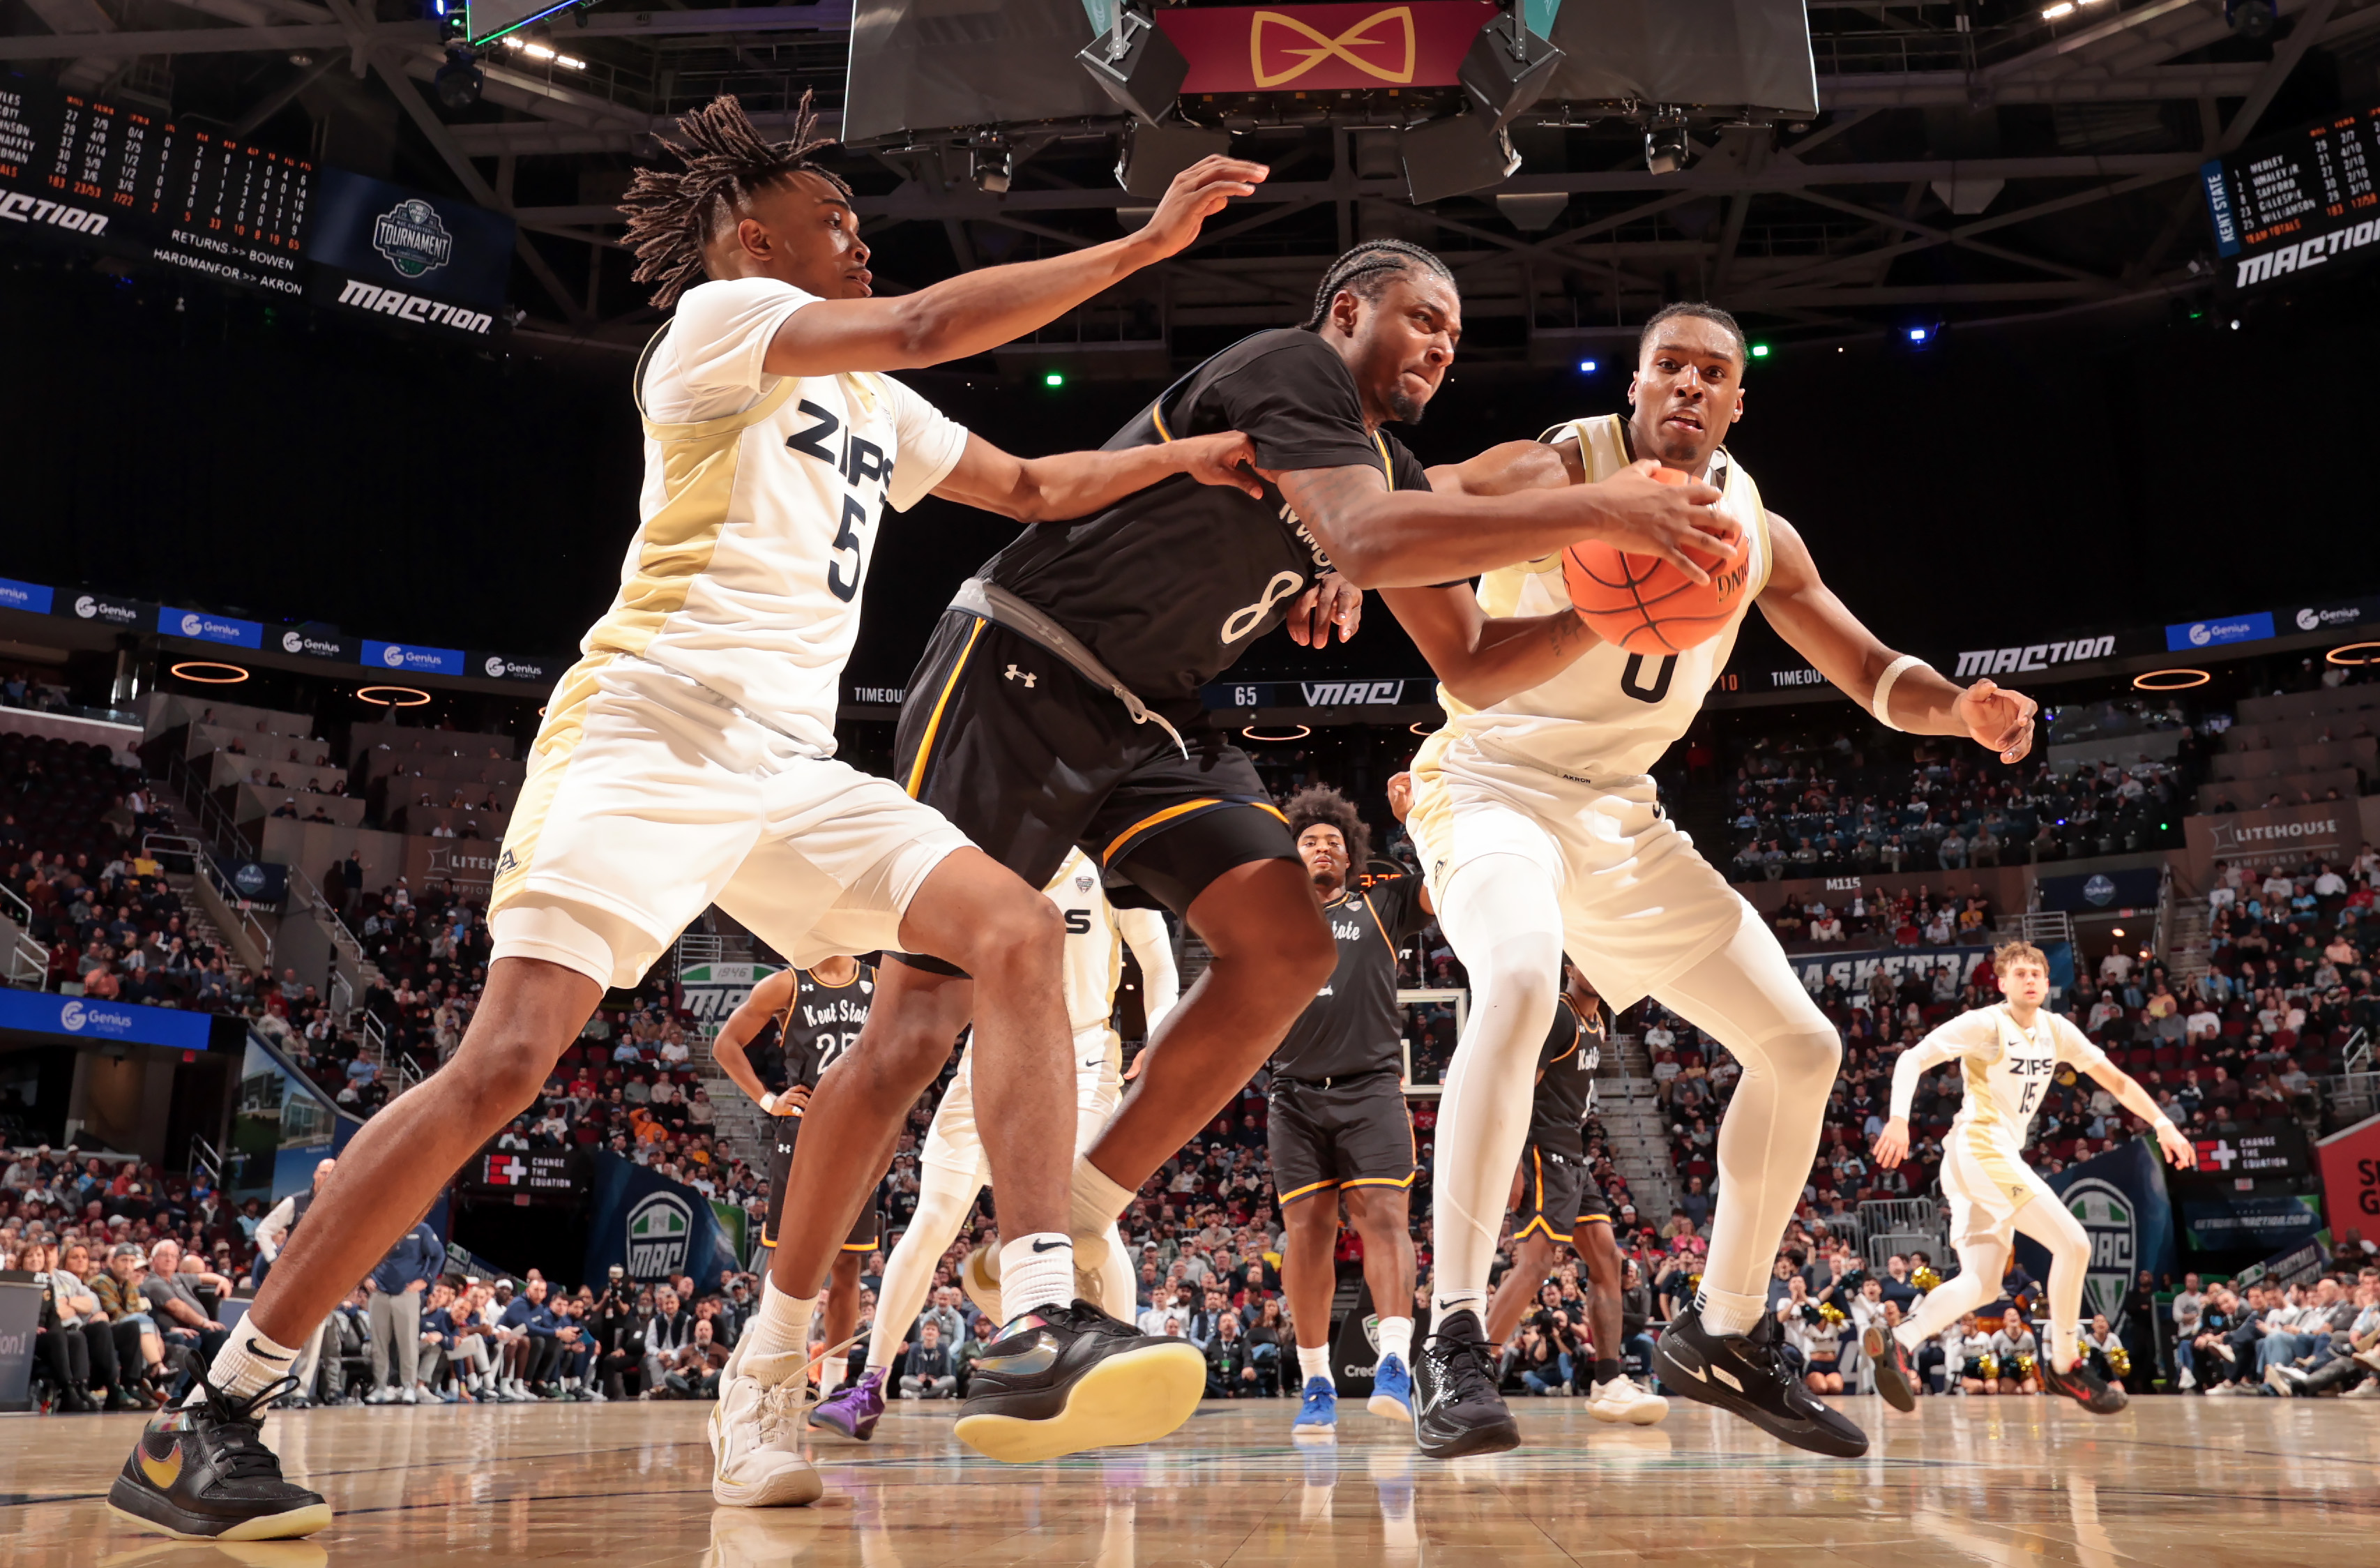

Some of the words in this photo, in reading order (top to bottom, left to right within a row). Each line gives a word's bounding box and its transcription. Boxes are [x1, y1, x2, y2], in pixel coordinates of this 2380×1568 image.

[128, 126, 144, 140] 0/4
[296, 187, 307, 199] 14
[2208, 173, 2228, 211] STATE
[0, 189, 109, 236] CTION
[294, 199, 304, 211] 16
[291, 211, 303, 225] 14
[2217, 213, 2236, 243] KENT
[379, 222, 448, 260] TOURNAMENT
[249, 249, 294, 271] BOWEN
[259, 275, 303, 296] AKRON
[338, 279, 492, 335] MACTION
[828, 492, 865, 603] 5
[0, 587, 29, 601] enius
[99, 603, 137, 619] Genius
[1220, 571, 1304, 644] 8
[2319, 607, 2360, 622] Genius
[204, 621, 241, 637] Genius
[2211, 622, 2251, 636] Genius
[303, 638, 340, 654] Genius
[406, 651, 442, 665] Genius
[1955, 635, 2116, 677] MACTION
[506, 662, 543, 676] Genius
[1720, 674, 1738, 691] 10
[1235, 686, 1257, 706] 65
[1562, 774, 1591, 784] AKRON
[2236, 820, 2337, 842] LITEHOUSE
[452, 854, 497, 870] LITEH
[1826, 876, 1861, 891] M115
[1332, 920, 1360, 941] tate
[681, 989, 751, 1018] MA
[803, 1002, 837, 1027] Kent
[839, 999, 871, 1024] Stat
[2009, 1057, 2052, 1075] ZIPS
[2019, 1082, 2038, 1113] 15
[2239, 1136, 2276, 1149] CHANGE
[2241, 1148, 2259, 1158] THE
[531, 1156, 566, 1168] CHANGE
[532, 1167, 547, 1177] THE
[2089, 1231, 2132, 1268] AC
[628, 1242, 683, 1279] MAC
[1344, 1364, 1377, 1378] Cred
